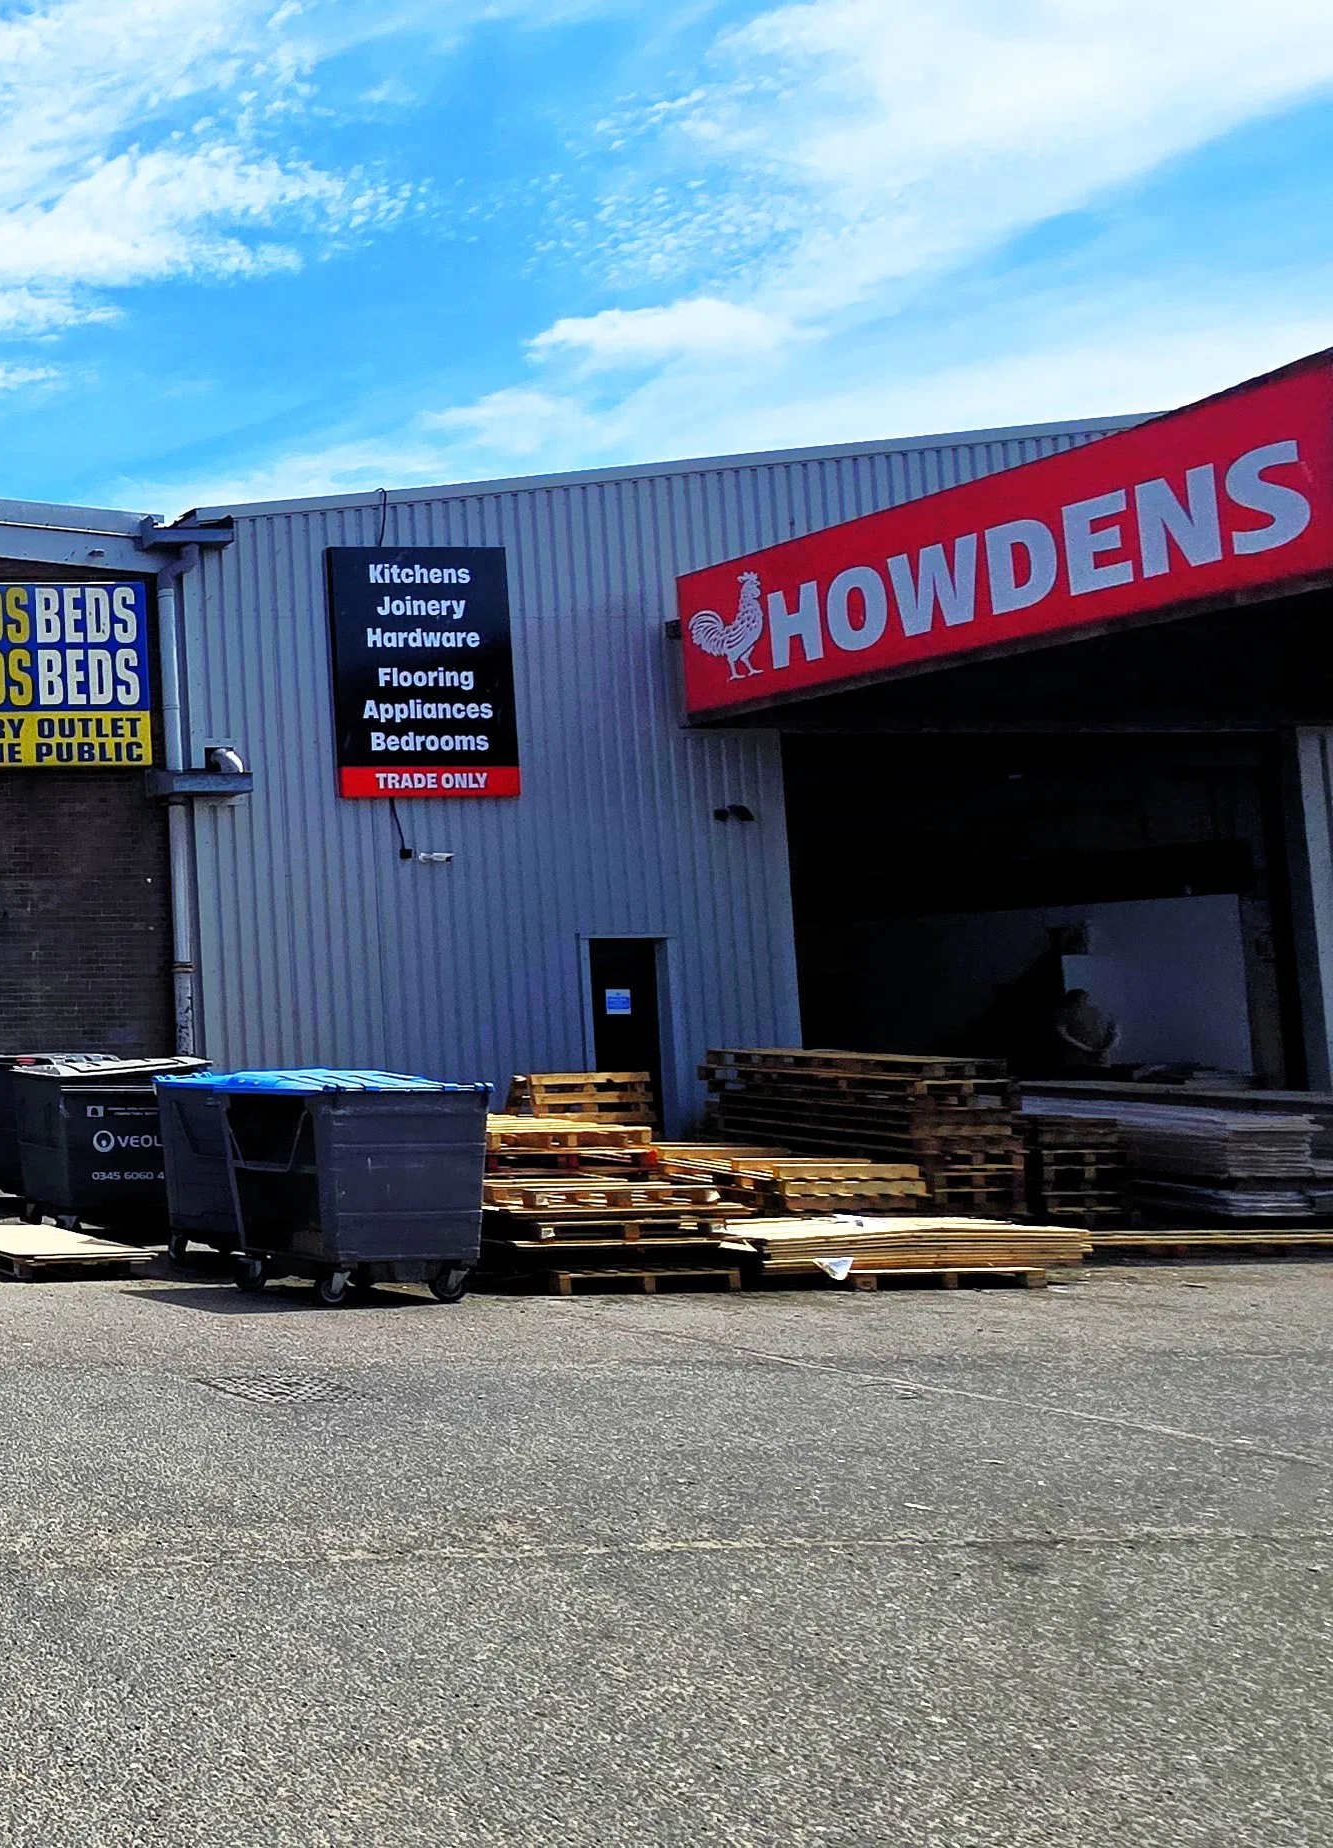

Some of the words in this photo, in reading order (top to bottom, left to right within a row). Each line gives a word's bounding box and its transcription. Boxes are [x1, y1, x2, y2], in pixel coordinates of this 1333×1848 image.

[766, 439, 1312, 670] HOWDENS
[368, 564, 472, 584] Kitchens
[35, 586, 137, 644] BEDS
[377, 596, 466, 620] Joinery
[366, 628, 481, 648] Hardware
[37, 648, 140, 706] BEDS
[378, 667, 474, 691] Flooring
[363, 699, 493, 723] Appliances
[36, 717, 141, 739] OUTLET
[35, 741, 144, 763] PUBLIC
[370, 731, 490, 751] Bedrooms
[375, 772, 438, 789] TRADE
[441, 772, 488, 789] ONLY
[116, 1134, 164, 1148] VEOL
[91, 1171, 121, 1180] 0345
[123, 1171, 154, 1180] 6060
